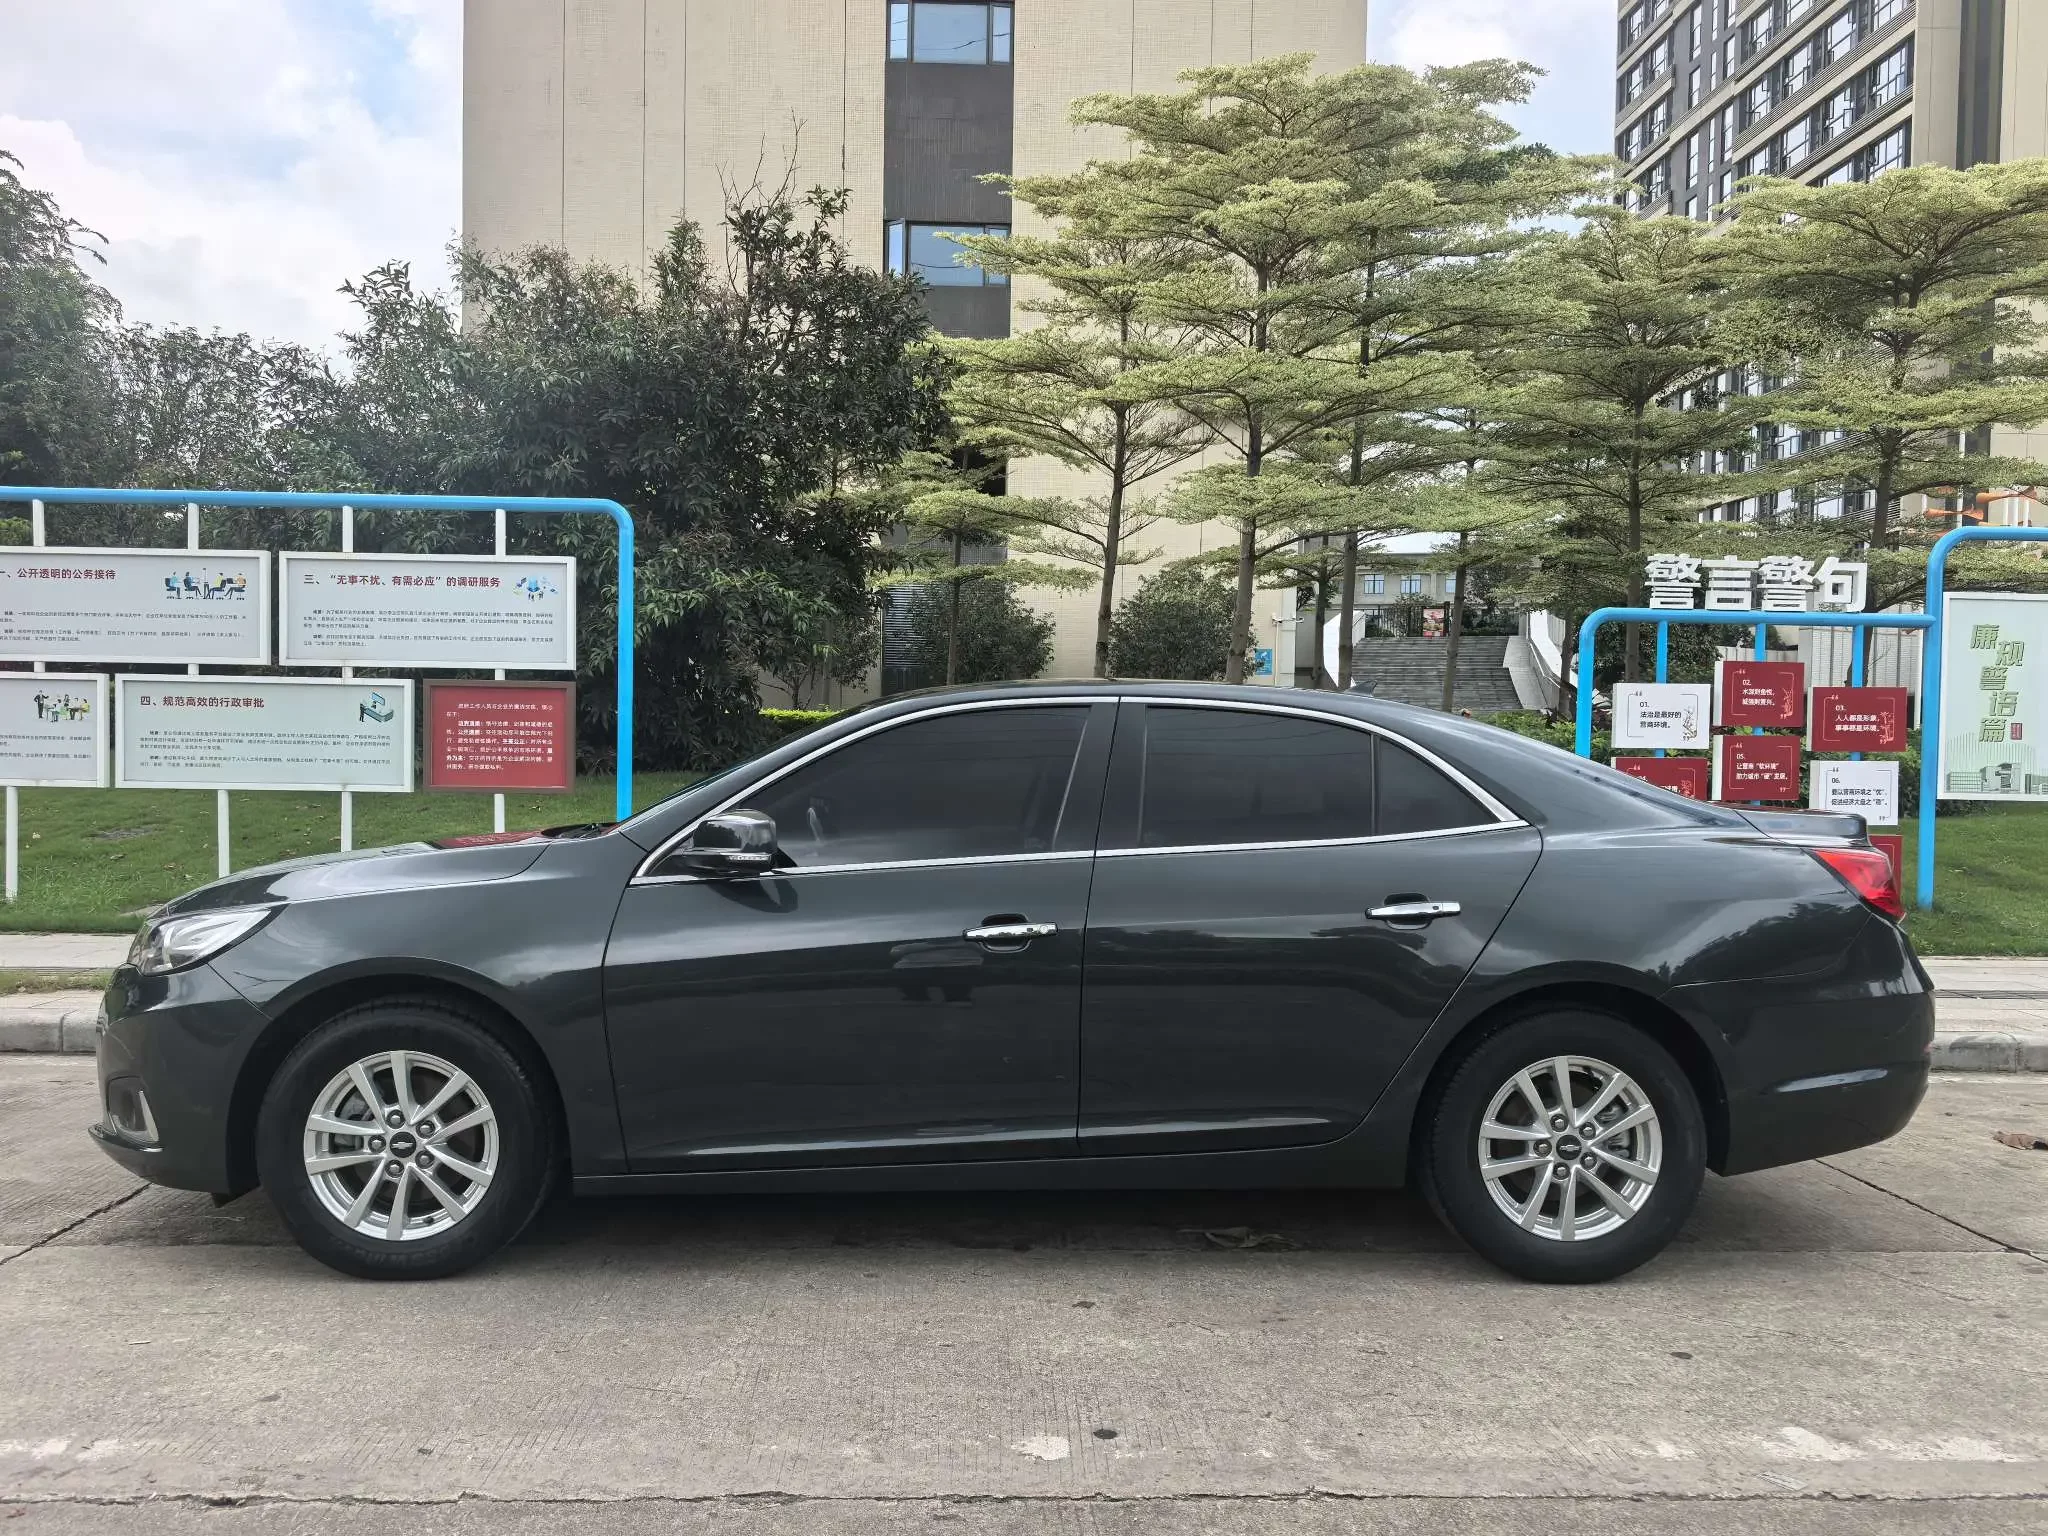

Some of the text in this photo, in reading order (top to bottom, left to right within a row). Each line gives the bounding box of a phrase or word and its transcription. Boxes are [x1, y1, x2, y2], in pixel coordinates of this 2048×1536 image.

[1645, 554, 1868, 612] 警言警句
[139, 695, 265, 708] 四、规范高效的行政审批
[1639, 711, 1682, 719] 法治是最好的
[1639, 721, 1671, 729] 营商环境。
